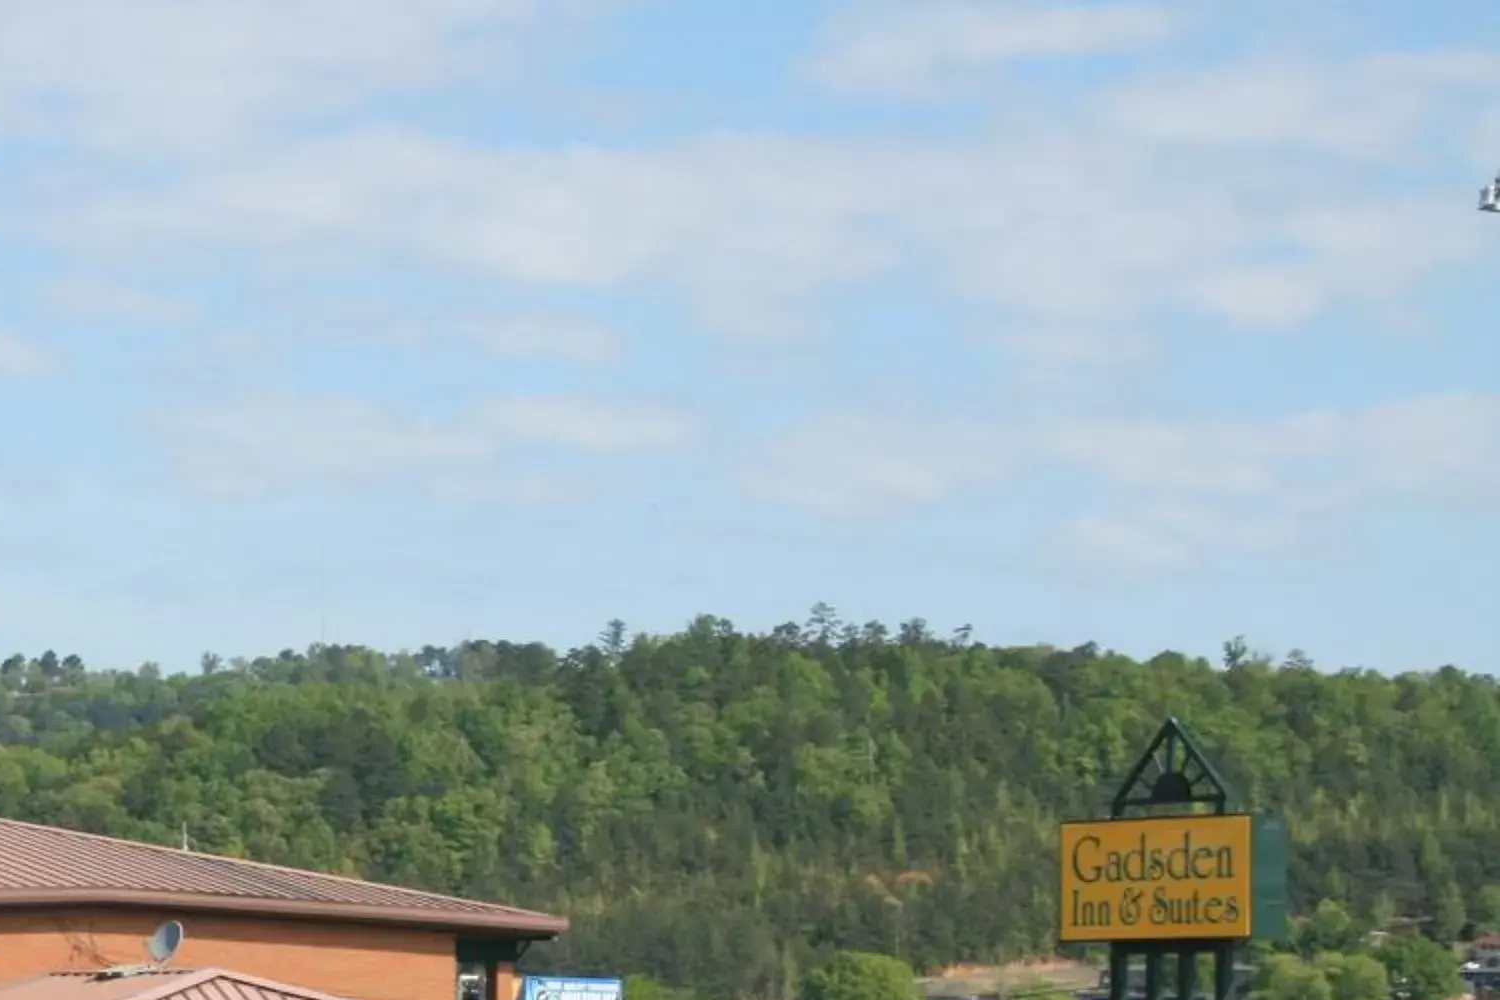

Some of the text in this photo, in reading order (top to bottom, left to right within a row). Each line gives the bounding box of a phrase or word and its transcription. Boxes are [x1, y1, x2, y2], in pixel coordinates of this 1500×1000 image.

[1072, 831, 1236, 883] Gadsden
[1069, 885, 1240, 927] Inn & Suites
